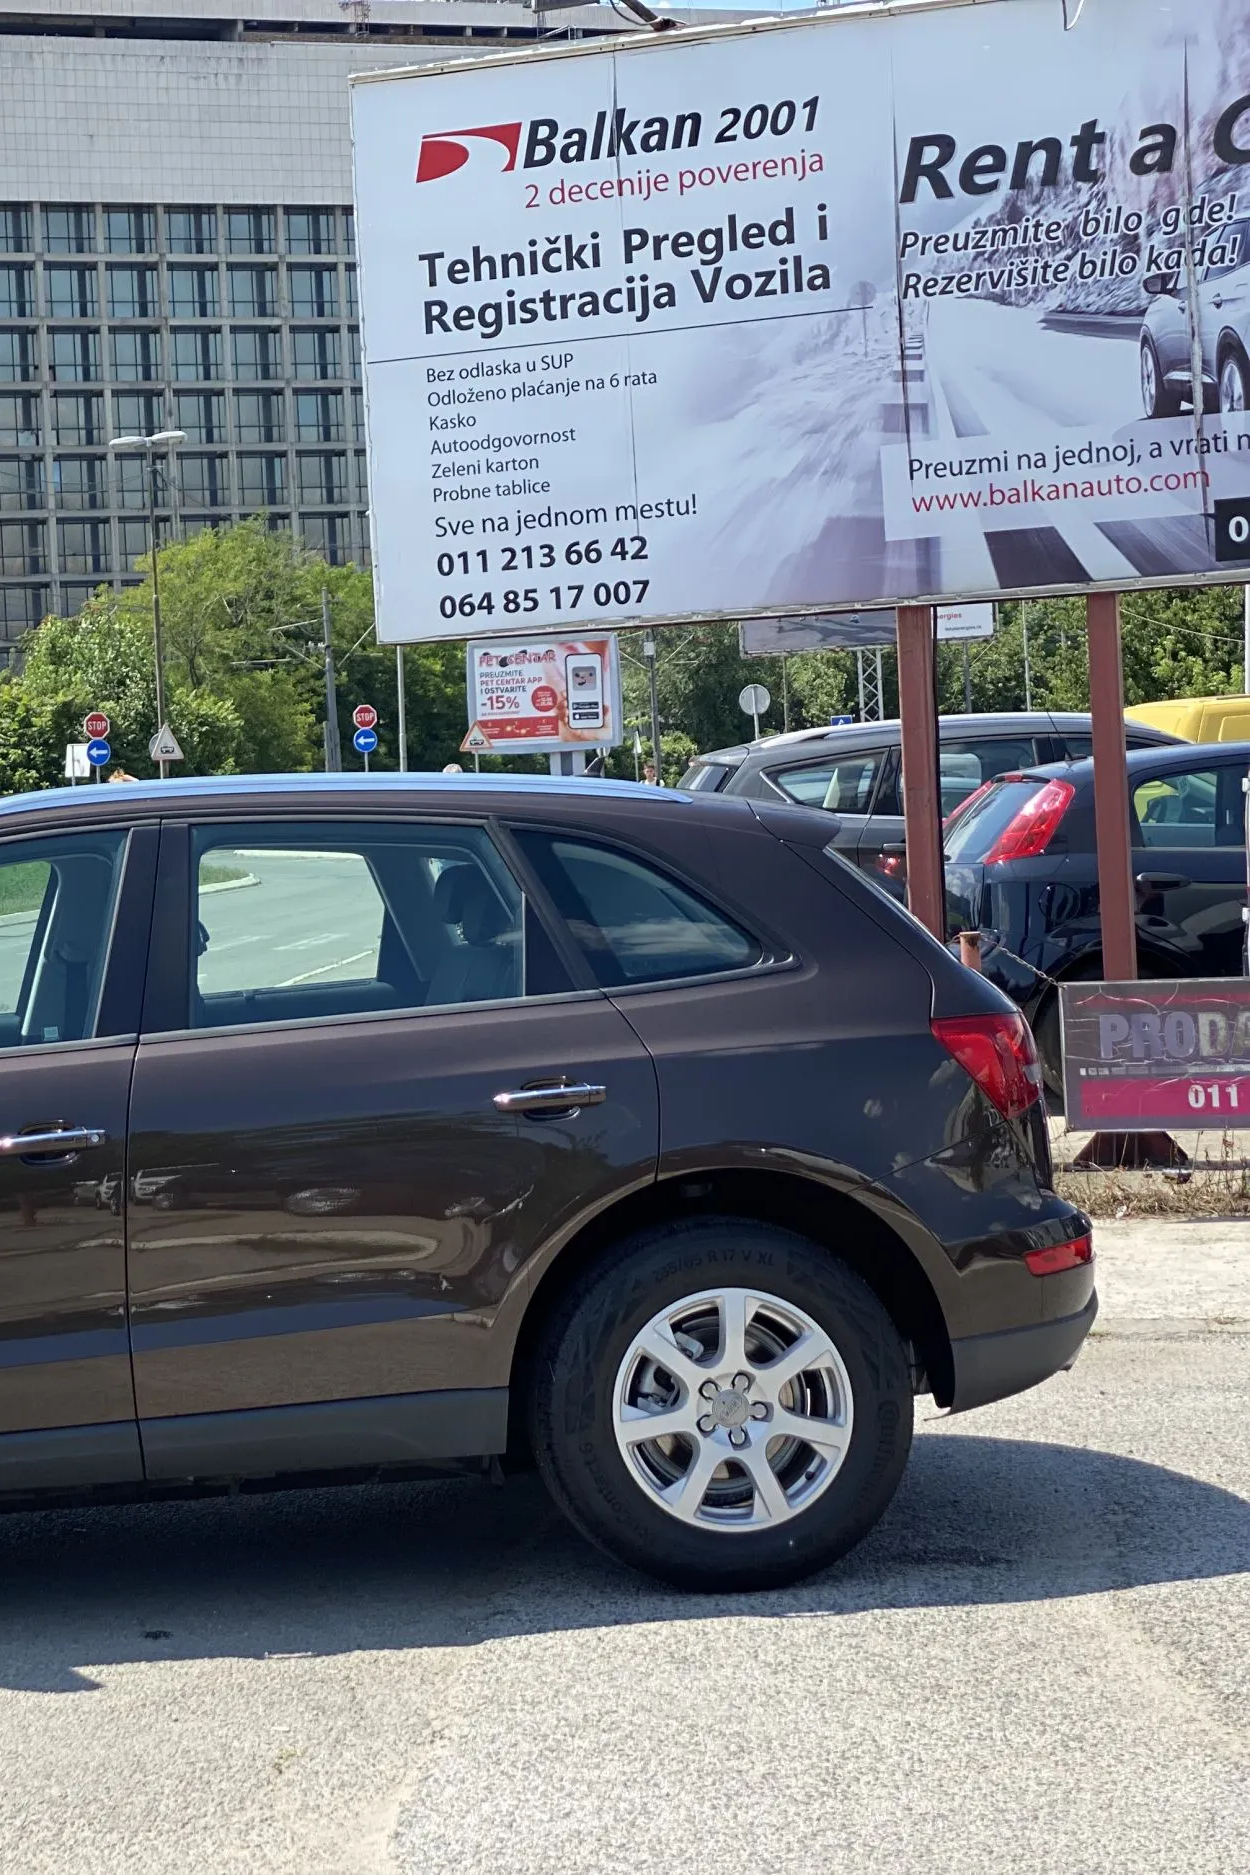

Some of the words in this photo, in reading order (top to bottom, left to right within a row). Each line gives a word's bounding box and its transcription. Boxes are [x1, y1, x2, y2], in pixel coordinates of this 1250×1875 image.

[523, 107, 703, 169] Balkan
[714, 95, 820, 145] 2001
[524, 184, 540, 208] 2
[549, 168, 669, 205] decenije
[678, 149, 824, 195] poverenja
[900, 118, 1106, 204] Rent
[1129, 123, 1177, 176] a
[418, 231, 602, 288] Tehnički
[623, 206, 796, 267] Pregled
[817, 203, 829, 241] i
[900, 217, 1062, 258] Preuzmite
[1081, 206, 1143, 237] bilo
[902, 258, 1070, 299] Rezervišite
[1078, 251, 1138, 280] bilo
[1146, 235, 1239, 273] kada!
[423, 274, 678, 339] Registracija
[690, 255, 832, 304] Vozila
[426, 368, 456, 383] Bez
[459, 361, 521, 380] odlaska
[526, 361, 537, 372] u
[541, 353, 574, 371] SUP
[427, 387, 507, 407] Odloženo
[512, 378, 581, 402] plaćanje
[585, 377, 605, 391] na
[609, 373, 620, 388] 6
[624, 371, 658, 387] rata
[429, 413, 477, 431] Kasko
[430, 428, 577, 455] Autoodgovornost
[910, 450, 1008, 481] Preuzmi
[1017, 452, 1048, 471] na
[1053, 438, 1143, 474] jednoj,
[1149, 441, 1163, 459] a
[1169, 430, 1228, 457] vrati
[431, 460, 481, 479] Zeleni
[486, 457, 539, 475] karton
[433, 485, 491, 502] Probne
[495, 478, 551, 498] tablice
[912, 468, 1211, 513] www.balkanauto.com
[435, 517, 475, 538] Sve
[482, 516, 509, 533] na
[515, 506, 608, 536] jednom
[616, 494, 697, 522] mestu!
[437, 549, 489, 577] 011
[501, 543, 556, 572] 213
[565, 539, 603, 566] 66
[610, 535, 649, 561] 42
[439, 592, 495, 619] 064
[503, 588, 540, 614] 85
[550, 584, 585, 610] 17
[593, 579, 650, 607] 007
[480, 669, 523, 679] PREUZMITE
[484, 685, 527, 695] OSTVARITE
[496, 678, 526, 686] CENTAR
[528, 676, 543, 684] APP
[356, 712, 375, 722] STOP
[480, 695, 520, 711] -15%
[88, 720, 107, 731] STOP
[1188, 1084, 1239, 1108] 011
